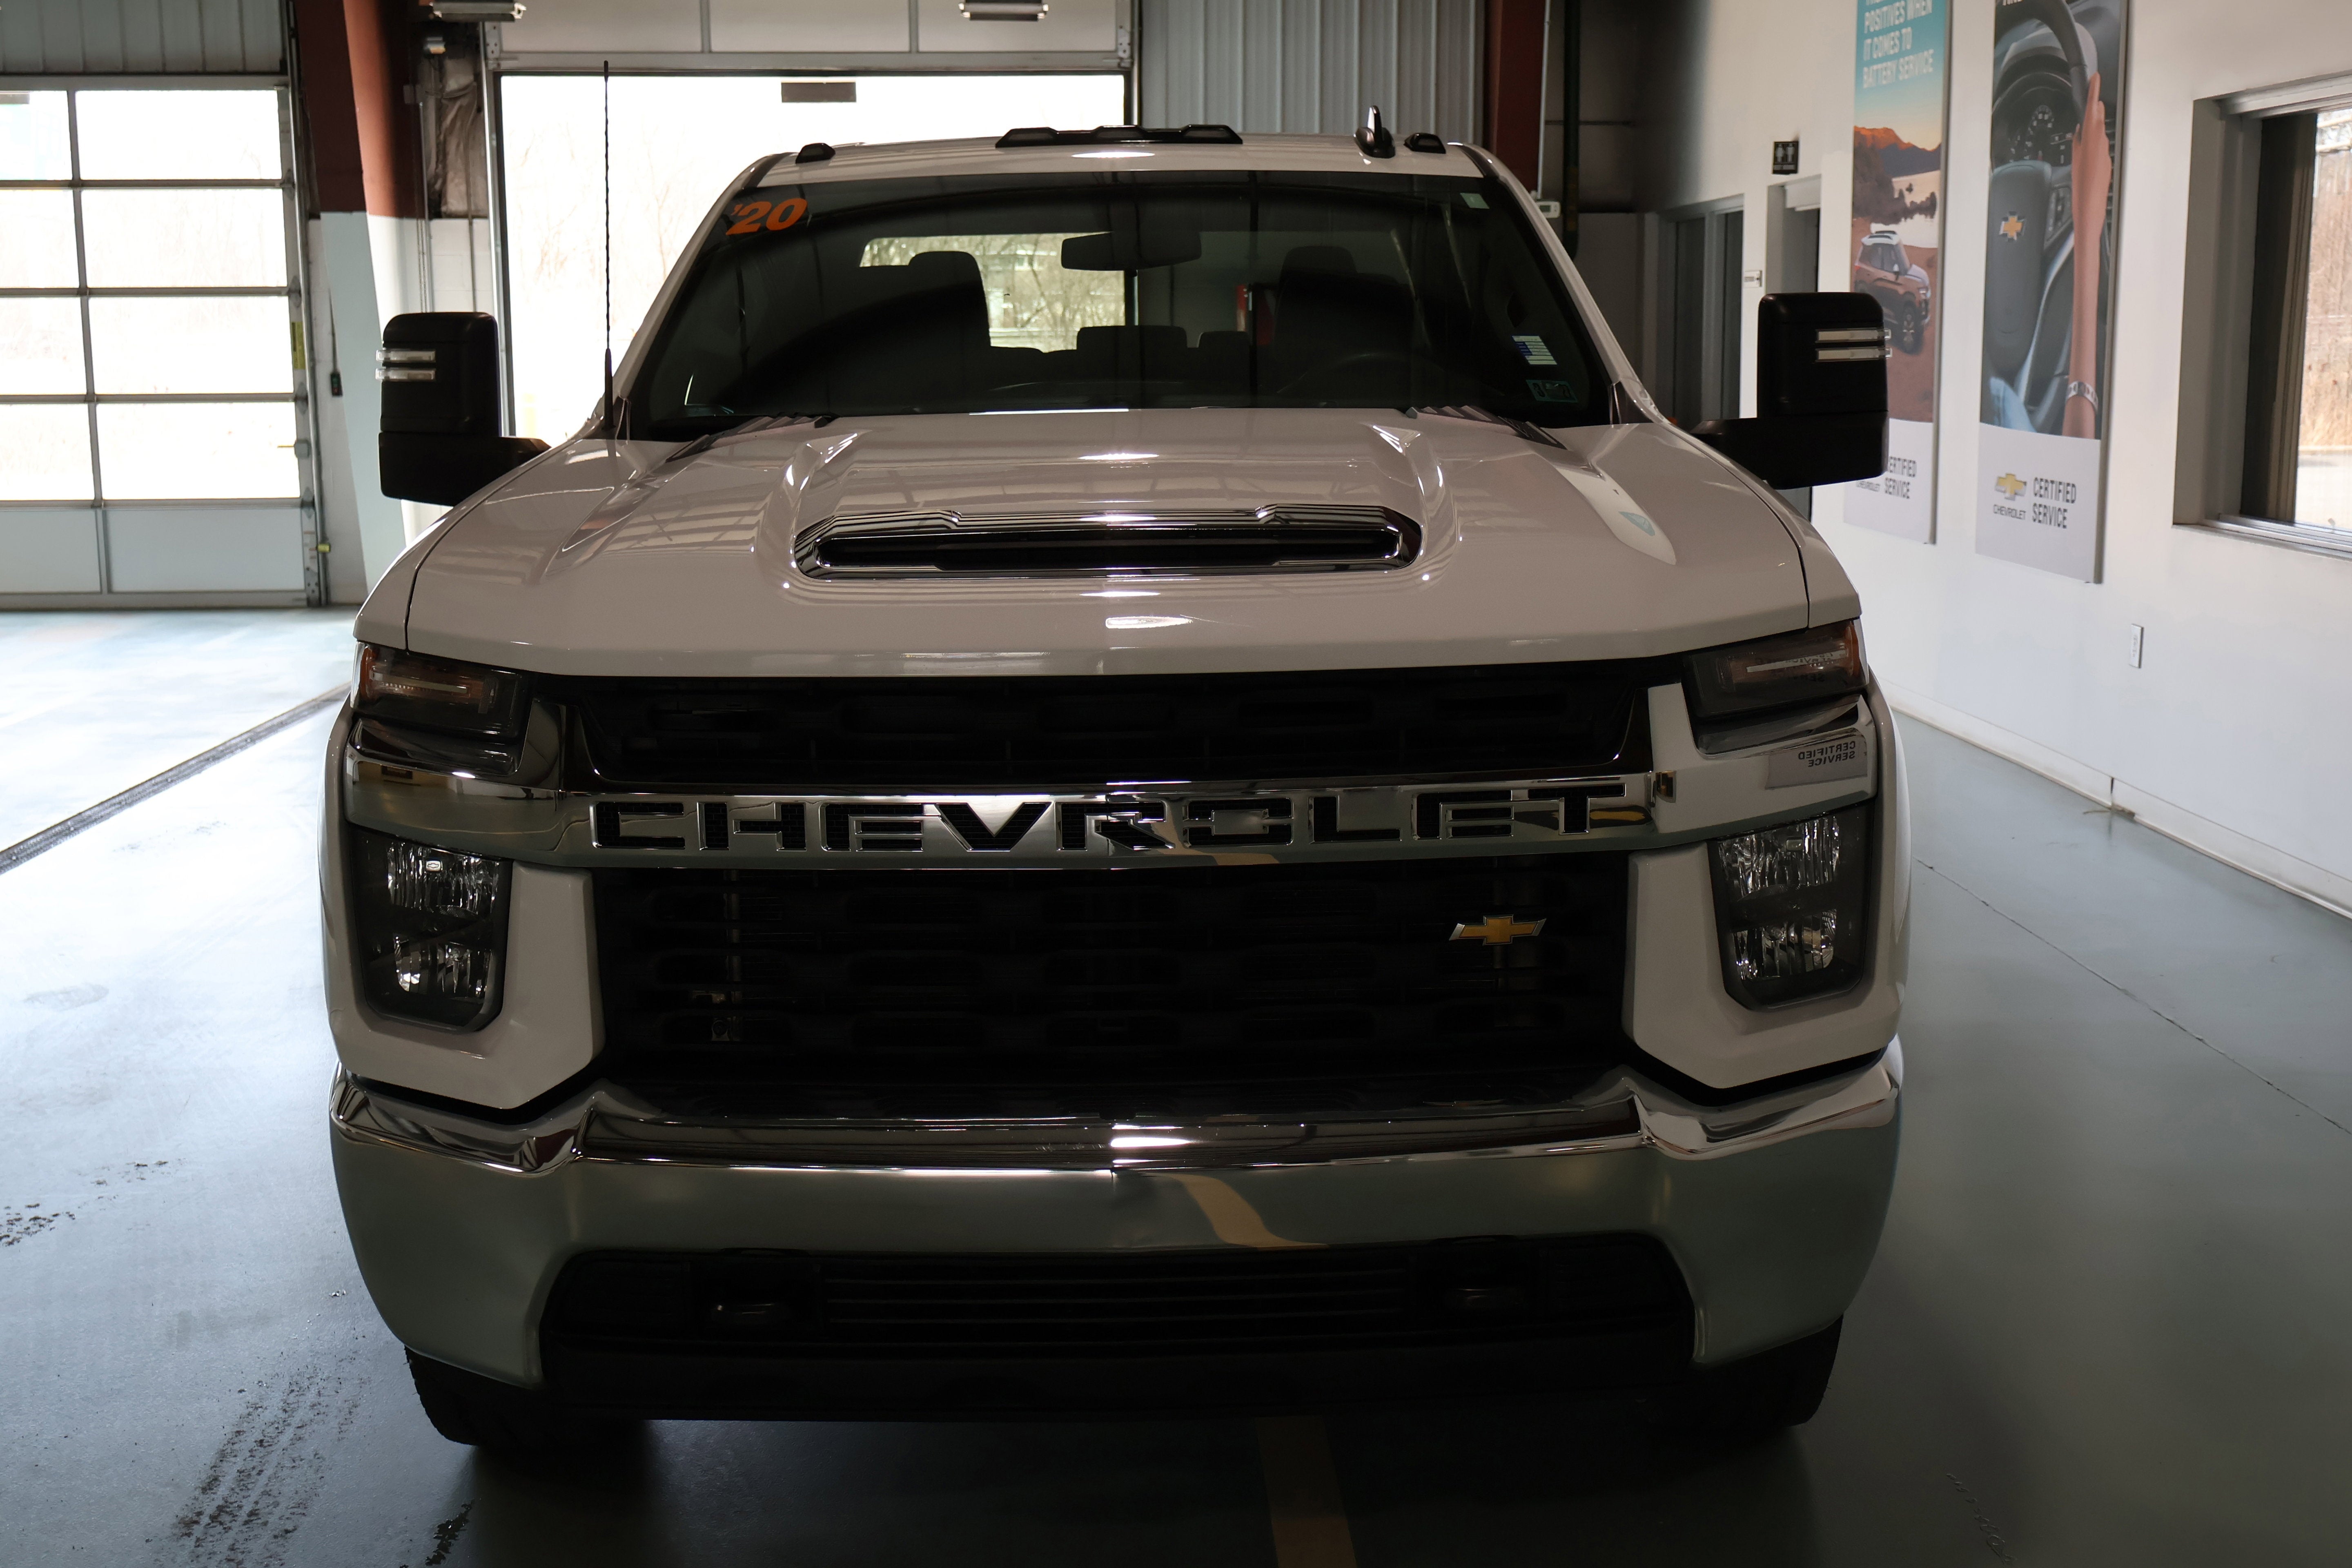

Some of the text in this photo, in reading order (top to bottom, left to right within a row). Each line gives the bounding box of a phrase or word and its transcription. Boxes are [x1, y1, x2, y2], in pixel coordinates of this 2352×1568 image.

[1864, 0, 1933, 33] POSITIVES WHEN
[1863, 27, 1912, 60] IT COMES TO
[1863, 49, 1934, 88] BATTERY SERVICE
[1889, 457, 1917, 477] ERTIFIED
[1884, 477, 1910, 499] SERVICE
[2033, 477, 2077, 503] CERTIFIED
[1993, 504, 2026, 520] CHEVROLET
[2032, 502, 2068, 529] SERVICE
[590, 784, 1626, 852] CHEVROLET
